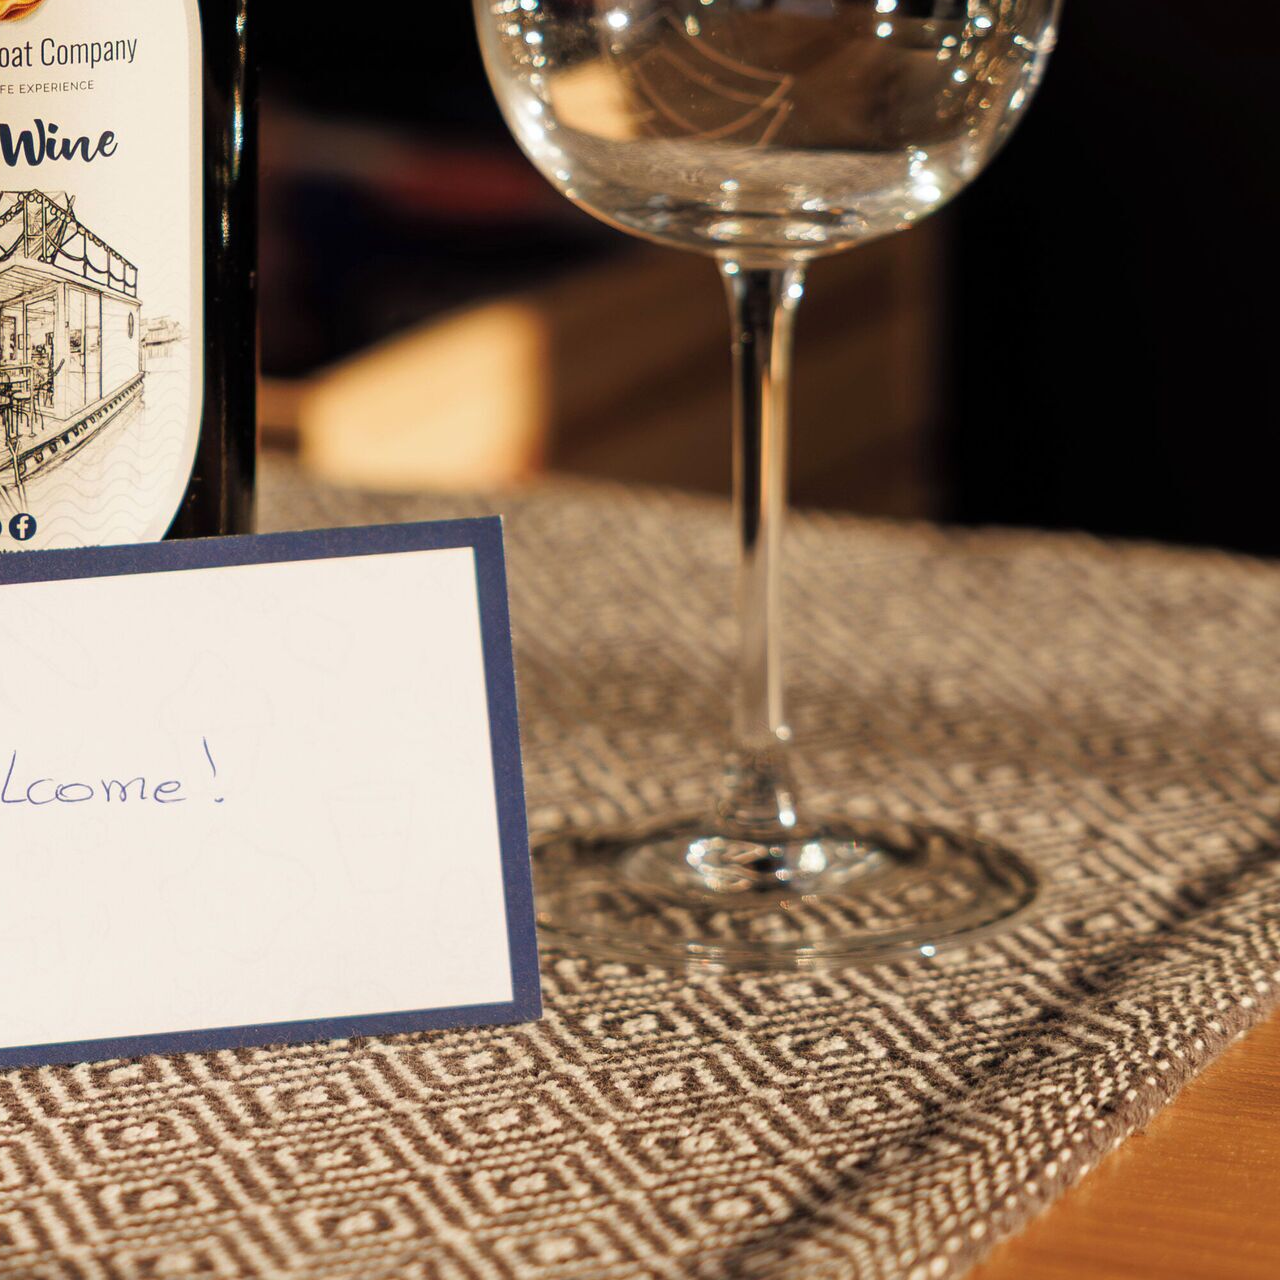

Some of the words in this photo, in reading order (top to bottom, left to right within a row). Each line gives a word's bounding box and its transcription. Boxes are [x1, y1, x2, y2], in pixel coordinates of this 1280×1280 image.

[40, 36, 138, 69] Company
[19, 80, 95, 94] EXPERIENCE
[0, 118, 119, 167] Wine
